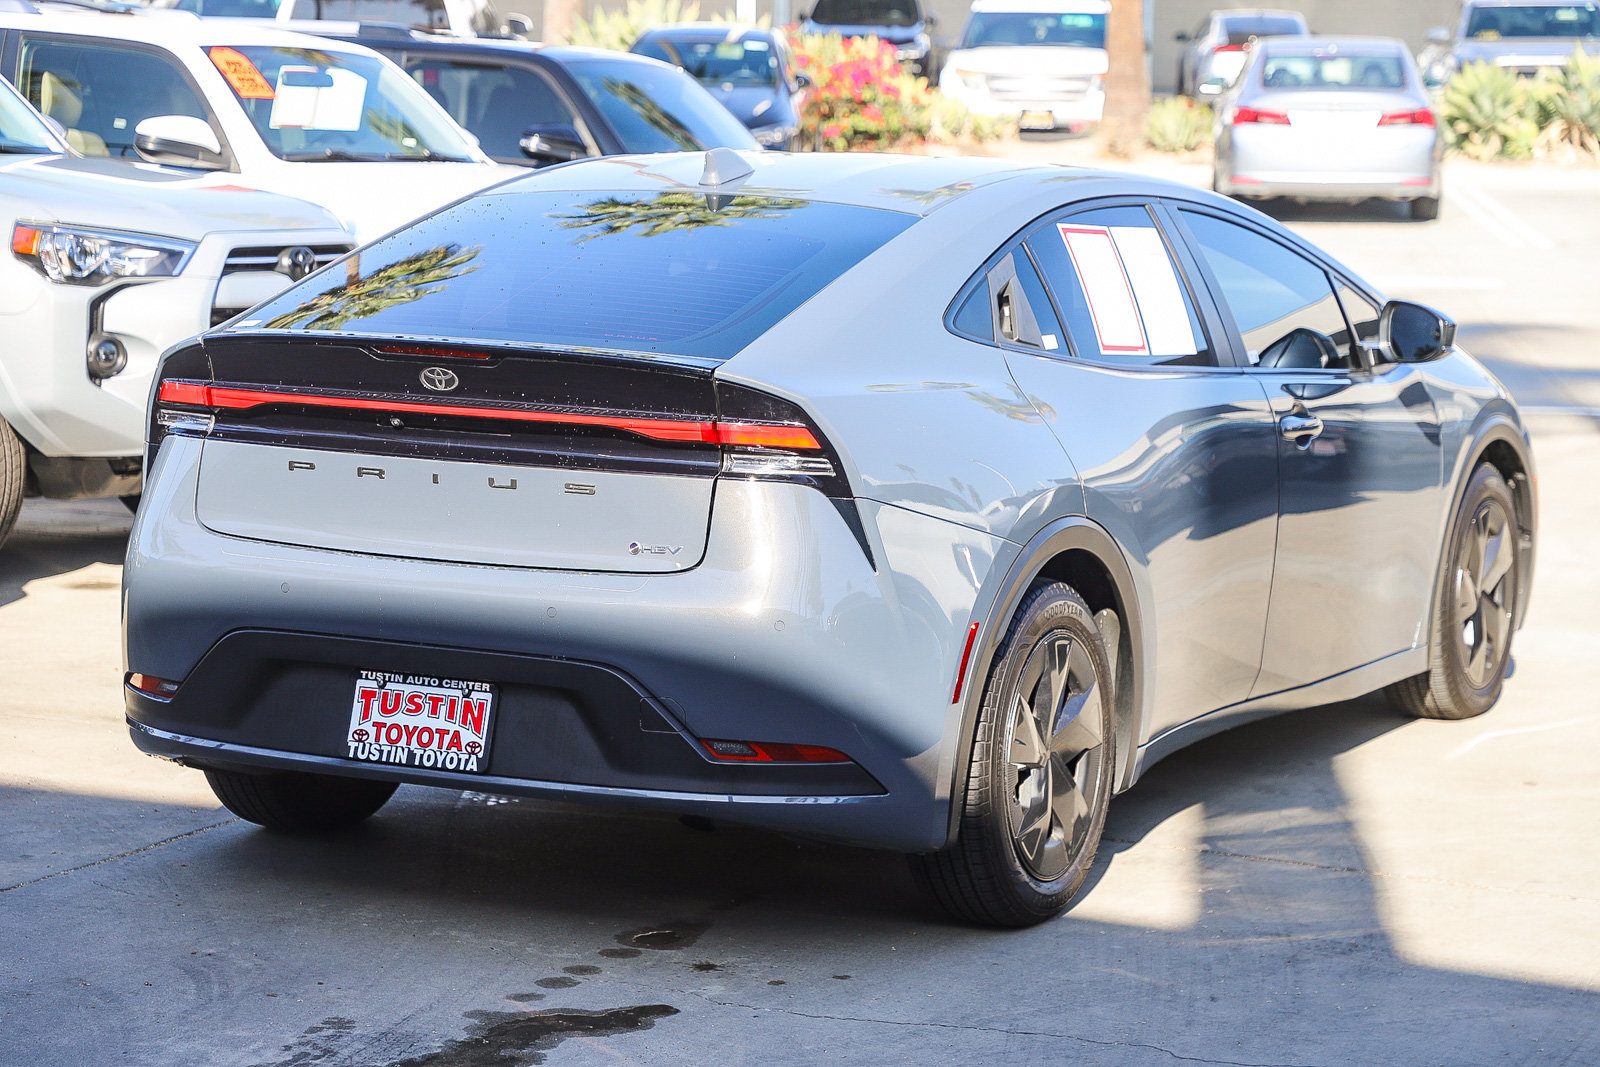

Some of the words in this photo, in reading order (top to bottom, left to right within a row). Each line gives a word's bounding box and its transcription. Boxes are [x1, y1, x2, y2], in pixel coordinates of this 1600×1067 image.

[288, 460, 596, 495] PRIUS
[360, 670, 403, 683] TUSTIN
[406, 675, 439, 687] AUTO
[442, 679, 490, 691] CENTER
[359, 687, 487, 738] TUSTIN
[372, 721, 463, 752] TOYOTA
[348, 741, 409, 764] TUSTIN
[413, 748, 478, 772] TOYOTA
